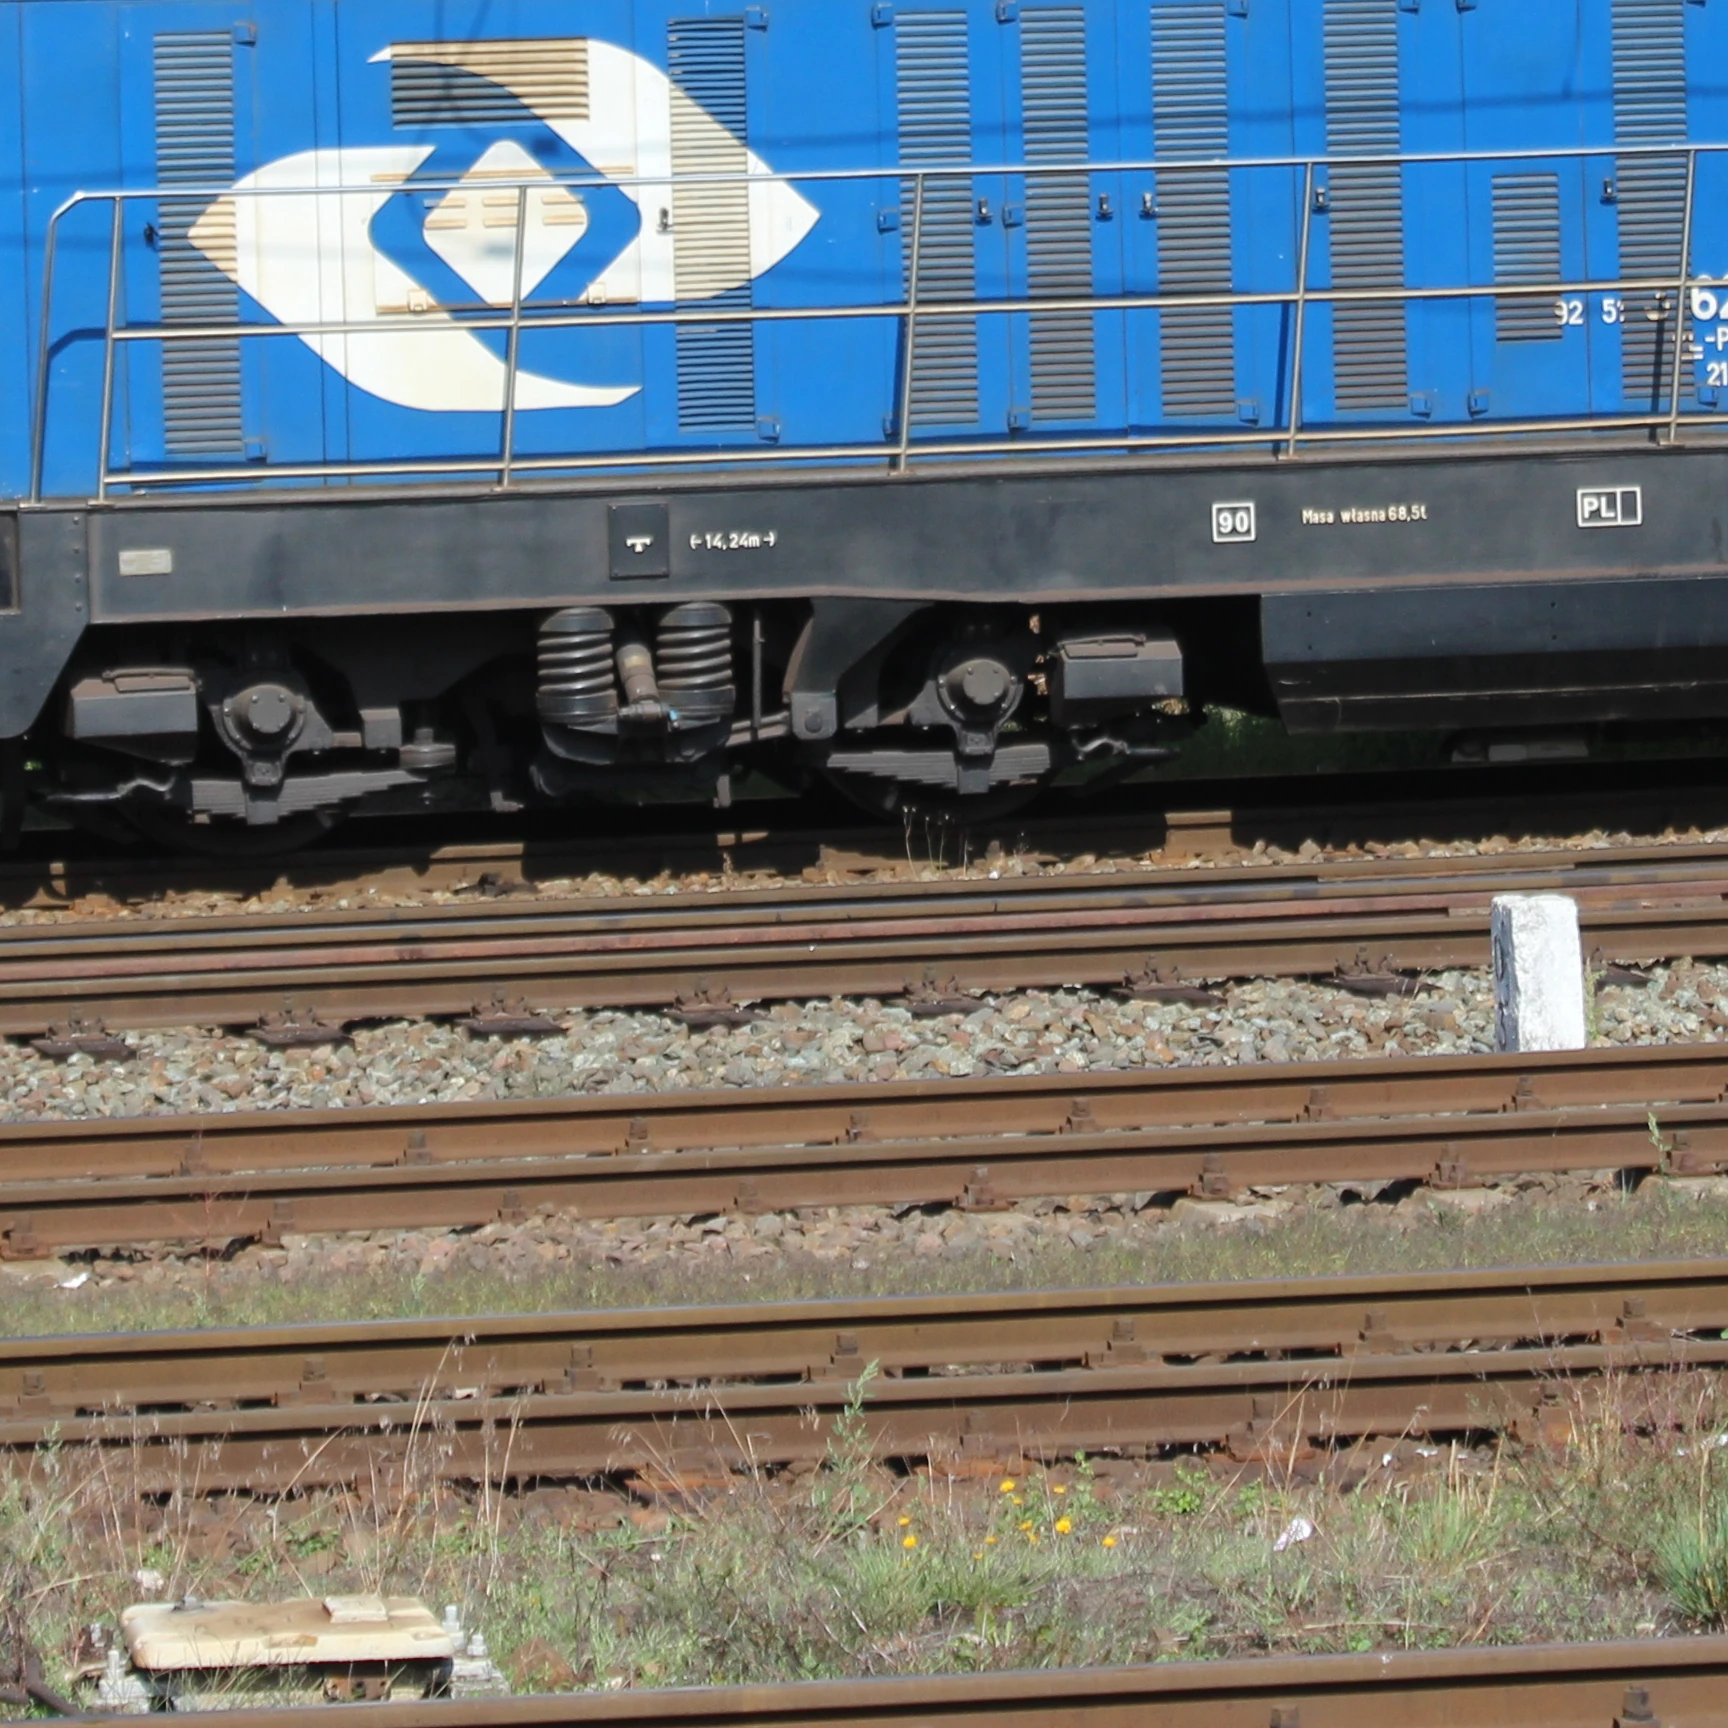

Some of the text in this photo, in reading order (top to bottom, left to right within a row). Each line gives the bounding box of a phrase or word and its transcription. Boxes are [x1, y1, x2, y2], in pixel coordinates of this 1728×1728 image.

[1302, 504, 1428, 525] Masa własna 68,5t
[1582, 496, 1616, 519] PL
[1218, 511, 1251, 534] 90
[705, 532, 761, 551] 14,24m
